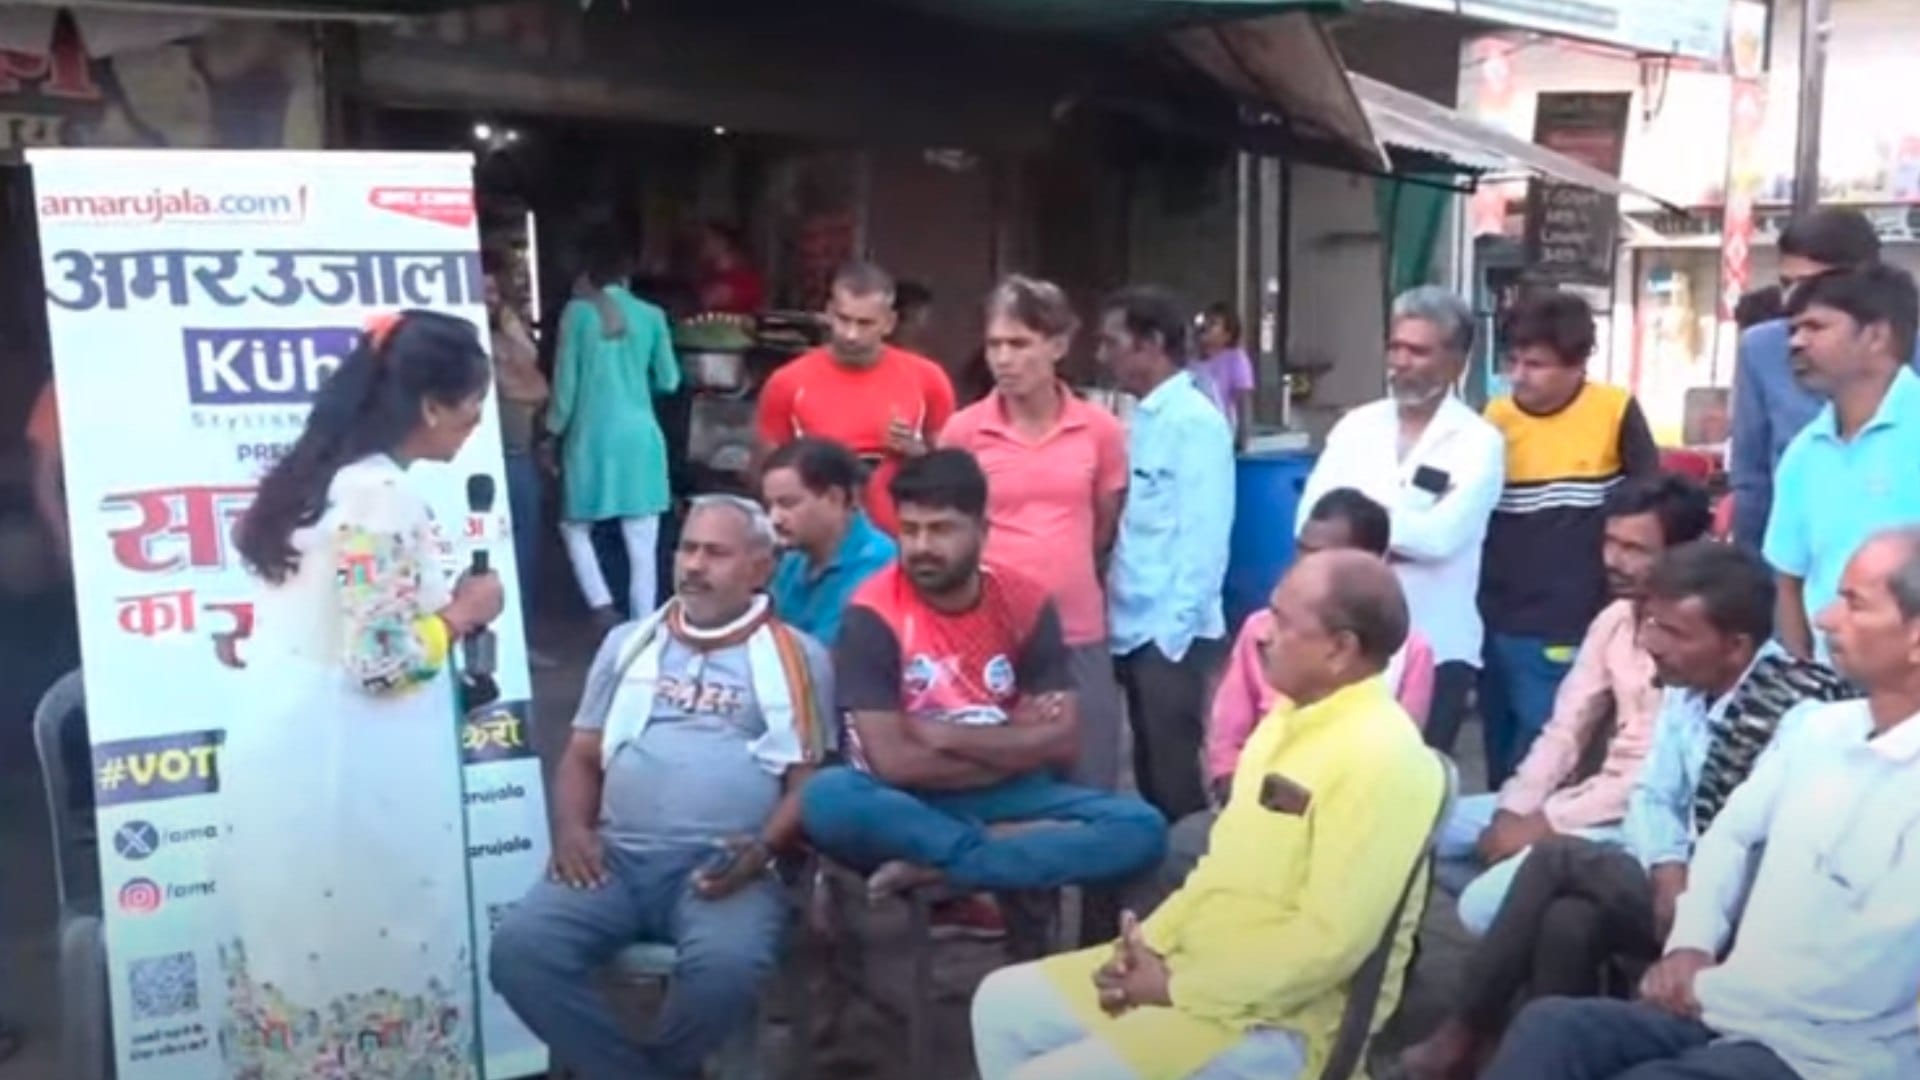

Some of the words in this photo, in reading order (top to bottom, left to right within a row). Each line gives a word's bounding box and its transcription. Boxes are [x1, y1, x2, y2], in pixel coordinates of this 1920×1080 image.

[40, 186, 292, 223] amarujala.com
[45, 248, 247, 311] अमर
[251, 249, 486, 305] उजाला
[197, 336, 359, 395] Küh
[115, 590, 195, 637] का
[99, 743, 221, 791] #VOT
